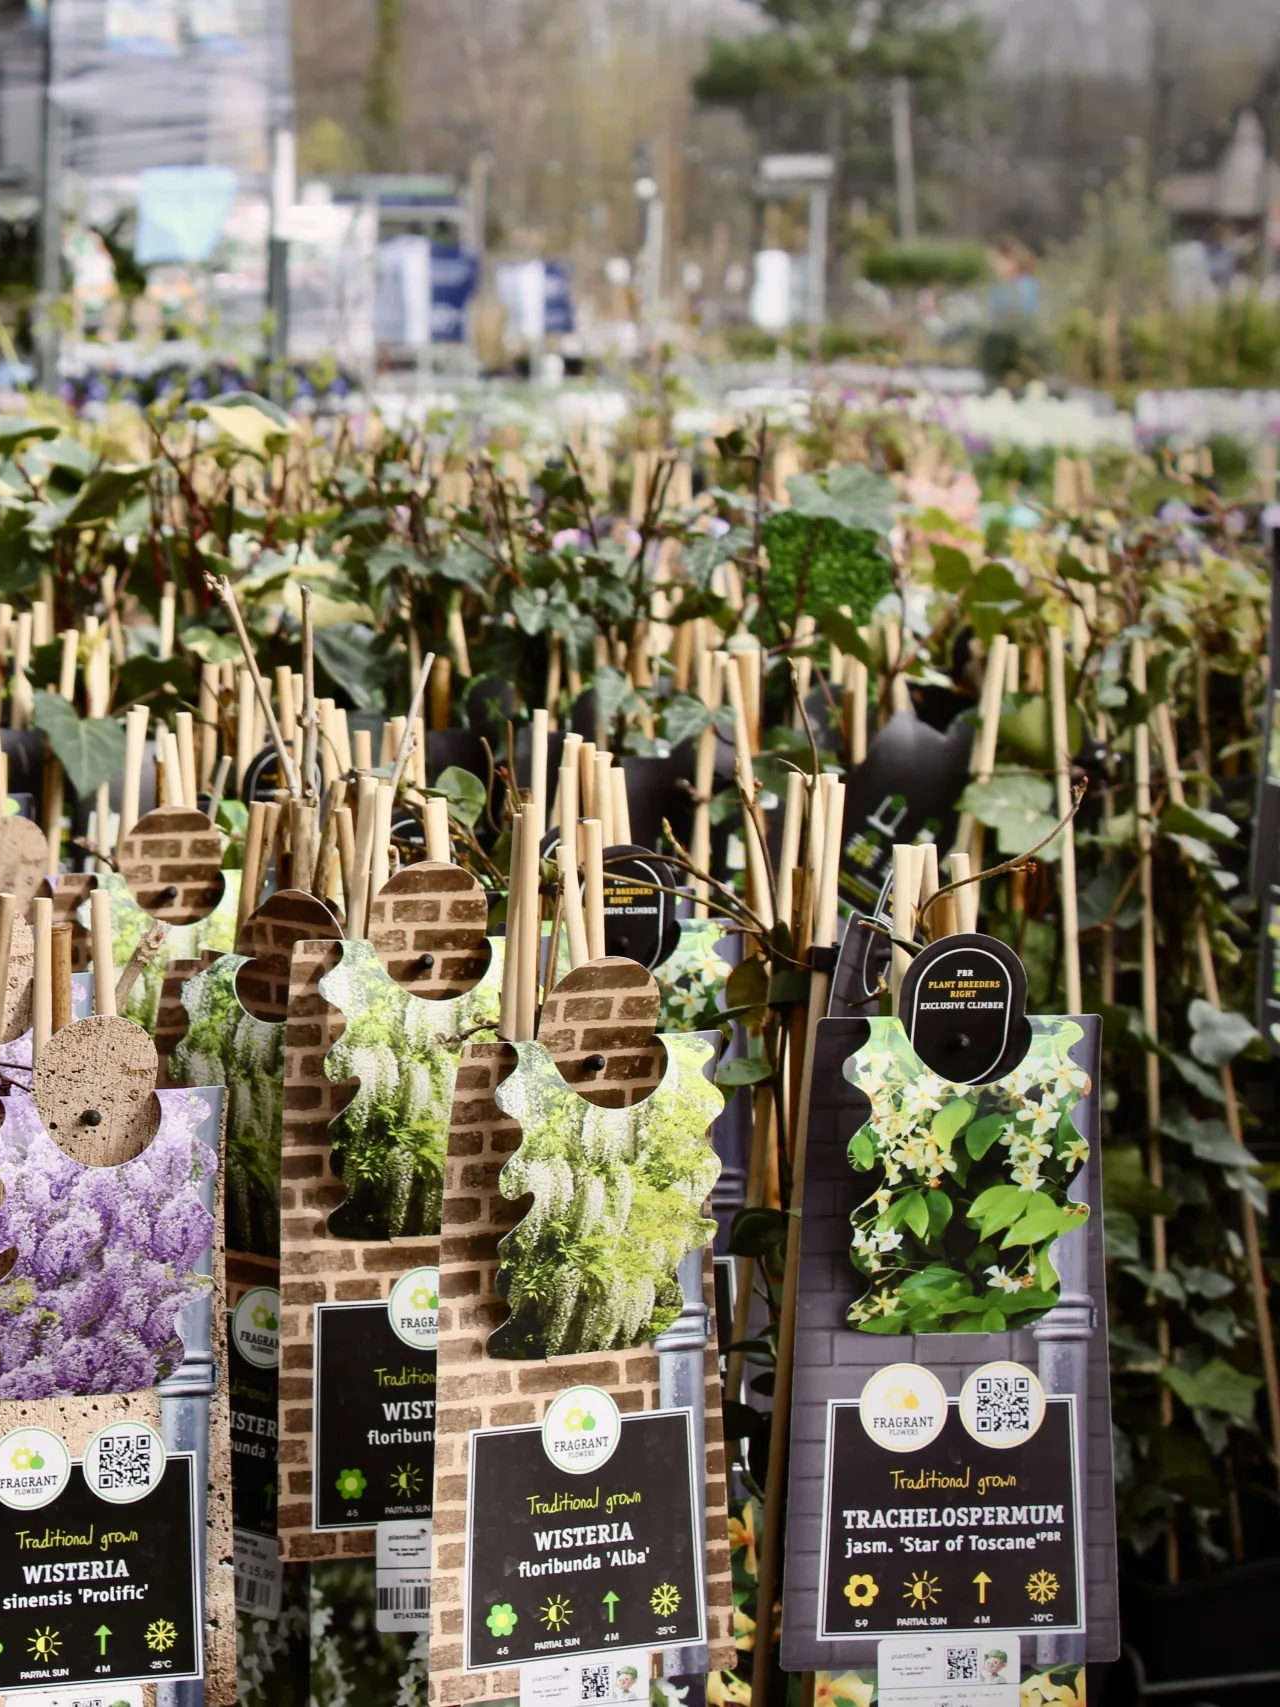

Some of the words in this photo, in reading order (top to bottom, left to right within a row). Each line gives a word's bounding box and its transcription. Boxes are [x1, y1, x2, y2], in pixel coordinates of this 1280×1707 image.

[625, 906, 658, 914] CLIMBER
[957, 969, 974, 977] PBR
[928, 981, 956, 989] PLANT
[958, 980, 1001, 988] BREEDERS
[950, 990, 977, 998] RIGHT
[920, 1002, 966, 1010] EXCLUSIVE
[967, 1001, 1004, 1009] CLIMBER
[373, 1366, 437, 1387] Tradition
[382, 1400, 436, 1421] WIST
[873, 1416, 934, 1429] FRAGRANT
[889, 1428, 919, 1437] FLOWERS
[554, 1436, 609, 1453] FRAGRANT
[568, 1449, 595, 1459] FLOWERS
[0, 1475, 58, 1489] FRAGRANT
[889, 1466, 970, 1491] Traditional
[977, 1475, 1017, 1496] grown
[14, 1487, 43, 1496] FLOWERS
[526, 1486, 599, 1516] Traditional
[605, 1491, 642, 1515] grown
[415, 1505, 431, 1513] SUN
[842, 1504, 1065, 1530] TRACHELOSPERMUM
[15, 1524, 93, 1550] Traditional
[100, 1530, 138, 1552] grown
[533, 1521, 634, 1552] WISTERIA
[844, 1538, 893, 1559] jasm.
[900, 1535, 939, 1553] 'Star
[945, 1534, 963, 1552] of
[518, 1554, 602, 1579] floribunda
[606, 1546, 650, 1568] 'Alba'
[22, 1559, 129, 1585] WISTERIA
[2, 1590, 72, 1610] sinensis
[78, 1584, 149, 1604] 'Prolific'
[896, 1617, 927, 1627] PARTIAL
[928, 1616, 948, 1626] SUN
[534, 1640, 562, 1652] PARTIAL
[562, 1637, 580, 1648] SUN
[20, 1669, 51, 1680] PARTIAL
[52, 1667, 69, 1677] SUN
